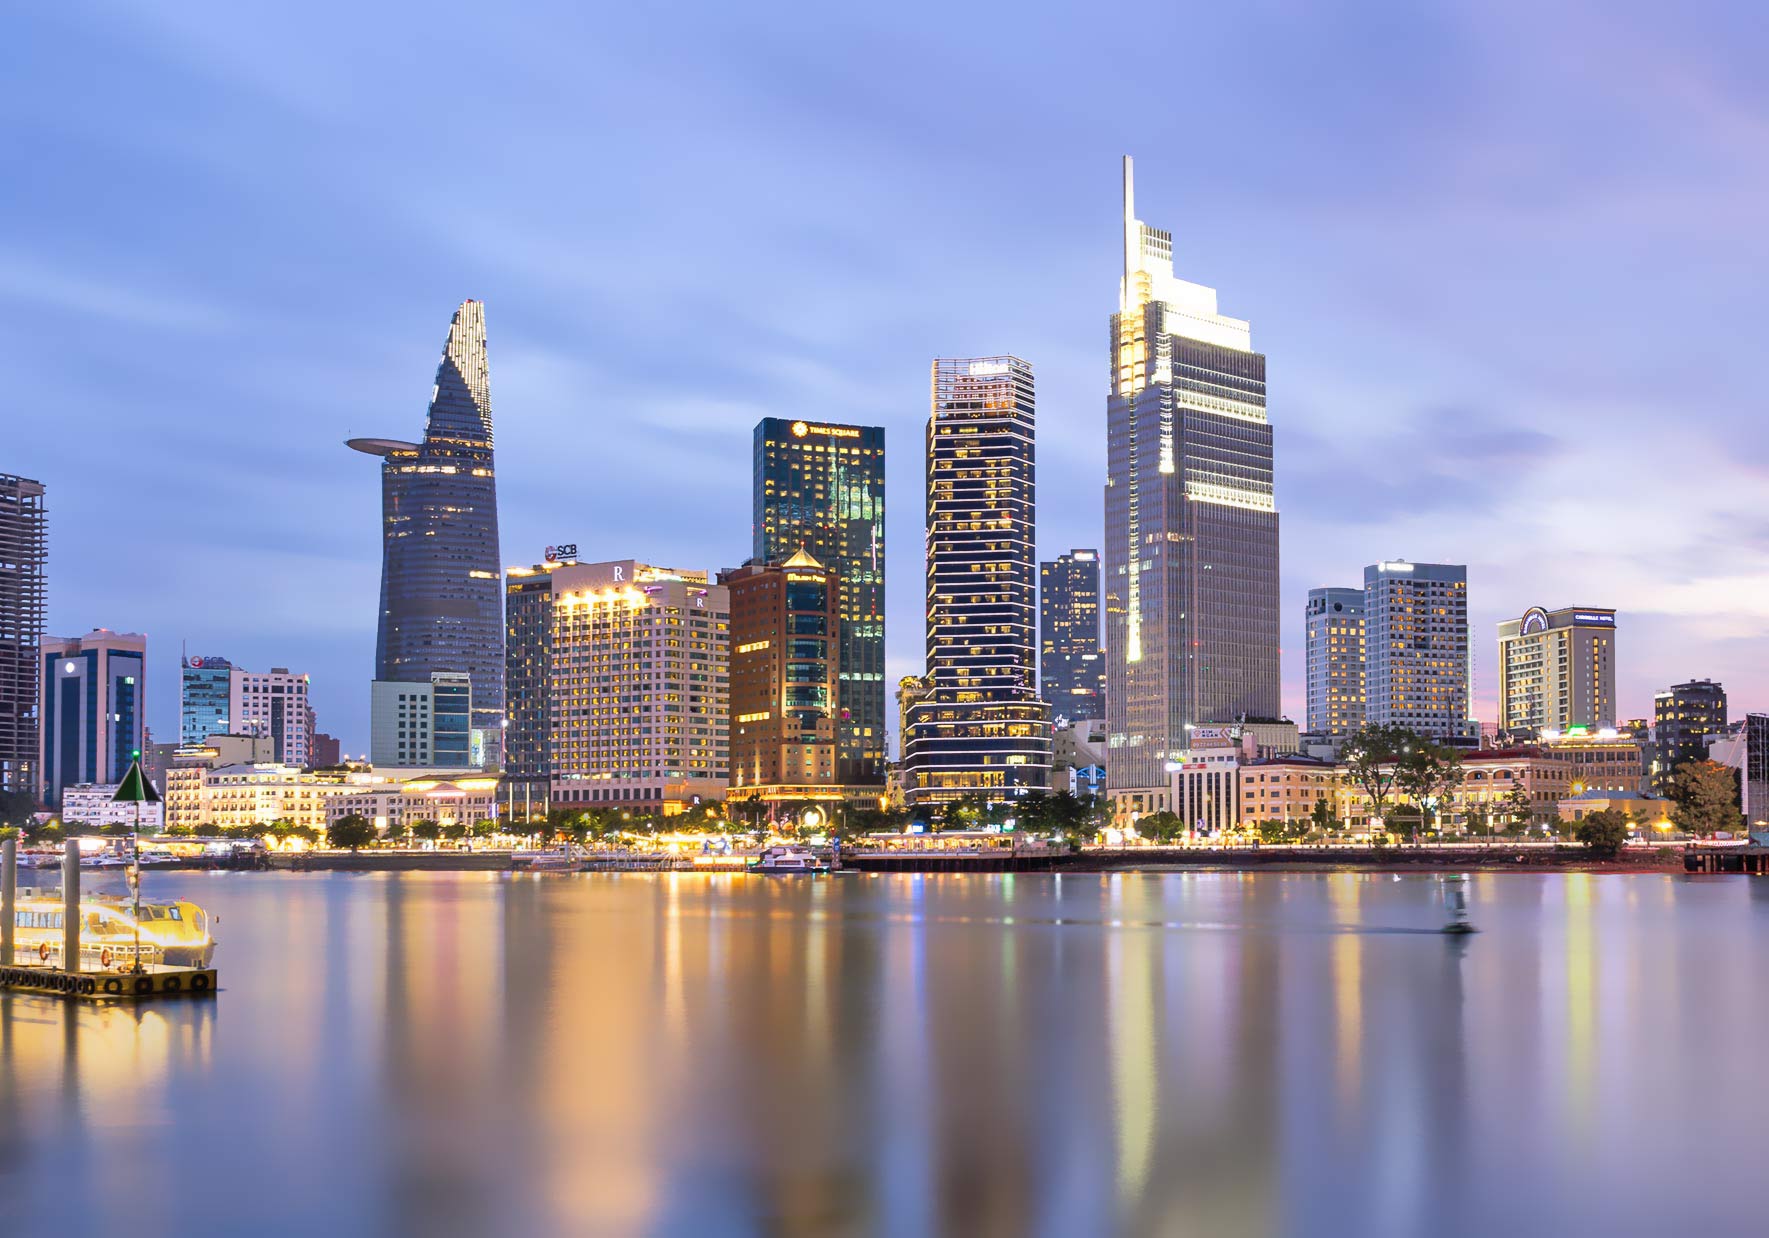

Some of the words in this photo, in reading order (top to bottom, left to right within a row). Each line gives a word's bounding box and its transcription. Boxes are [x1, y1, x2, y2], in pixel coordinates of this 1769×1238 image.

[810, 426, 830, 435] TIMES
[831, 428, 860, 437] SQUARE
[557, 544, 577, 556] SCB
[613, 565, 625, 582] R
[696, 597, 704, 608] R
[693, 796, 700, 805] R
